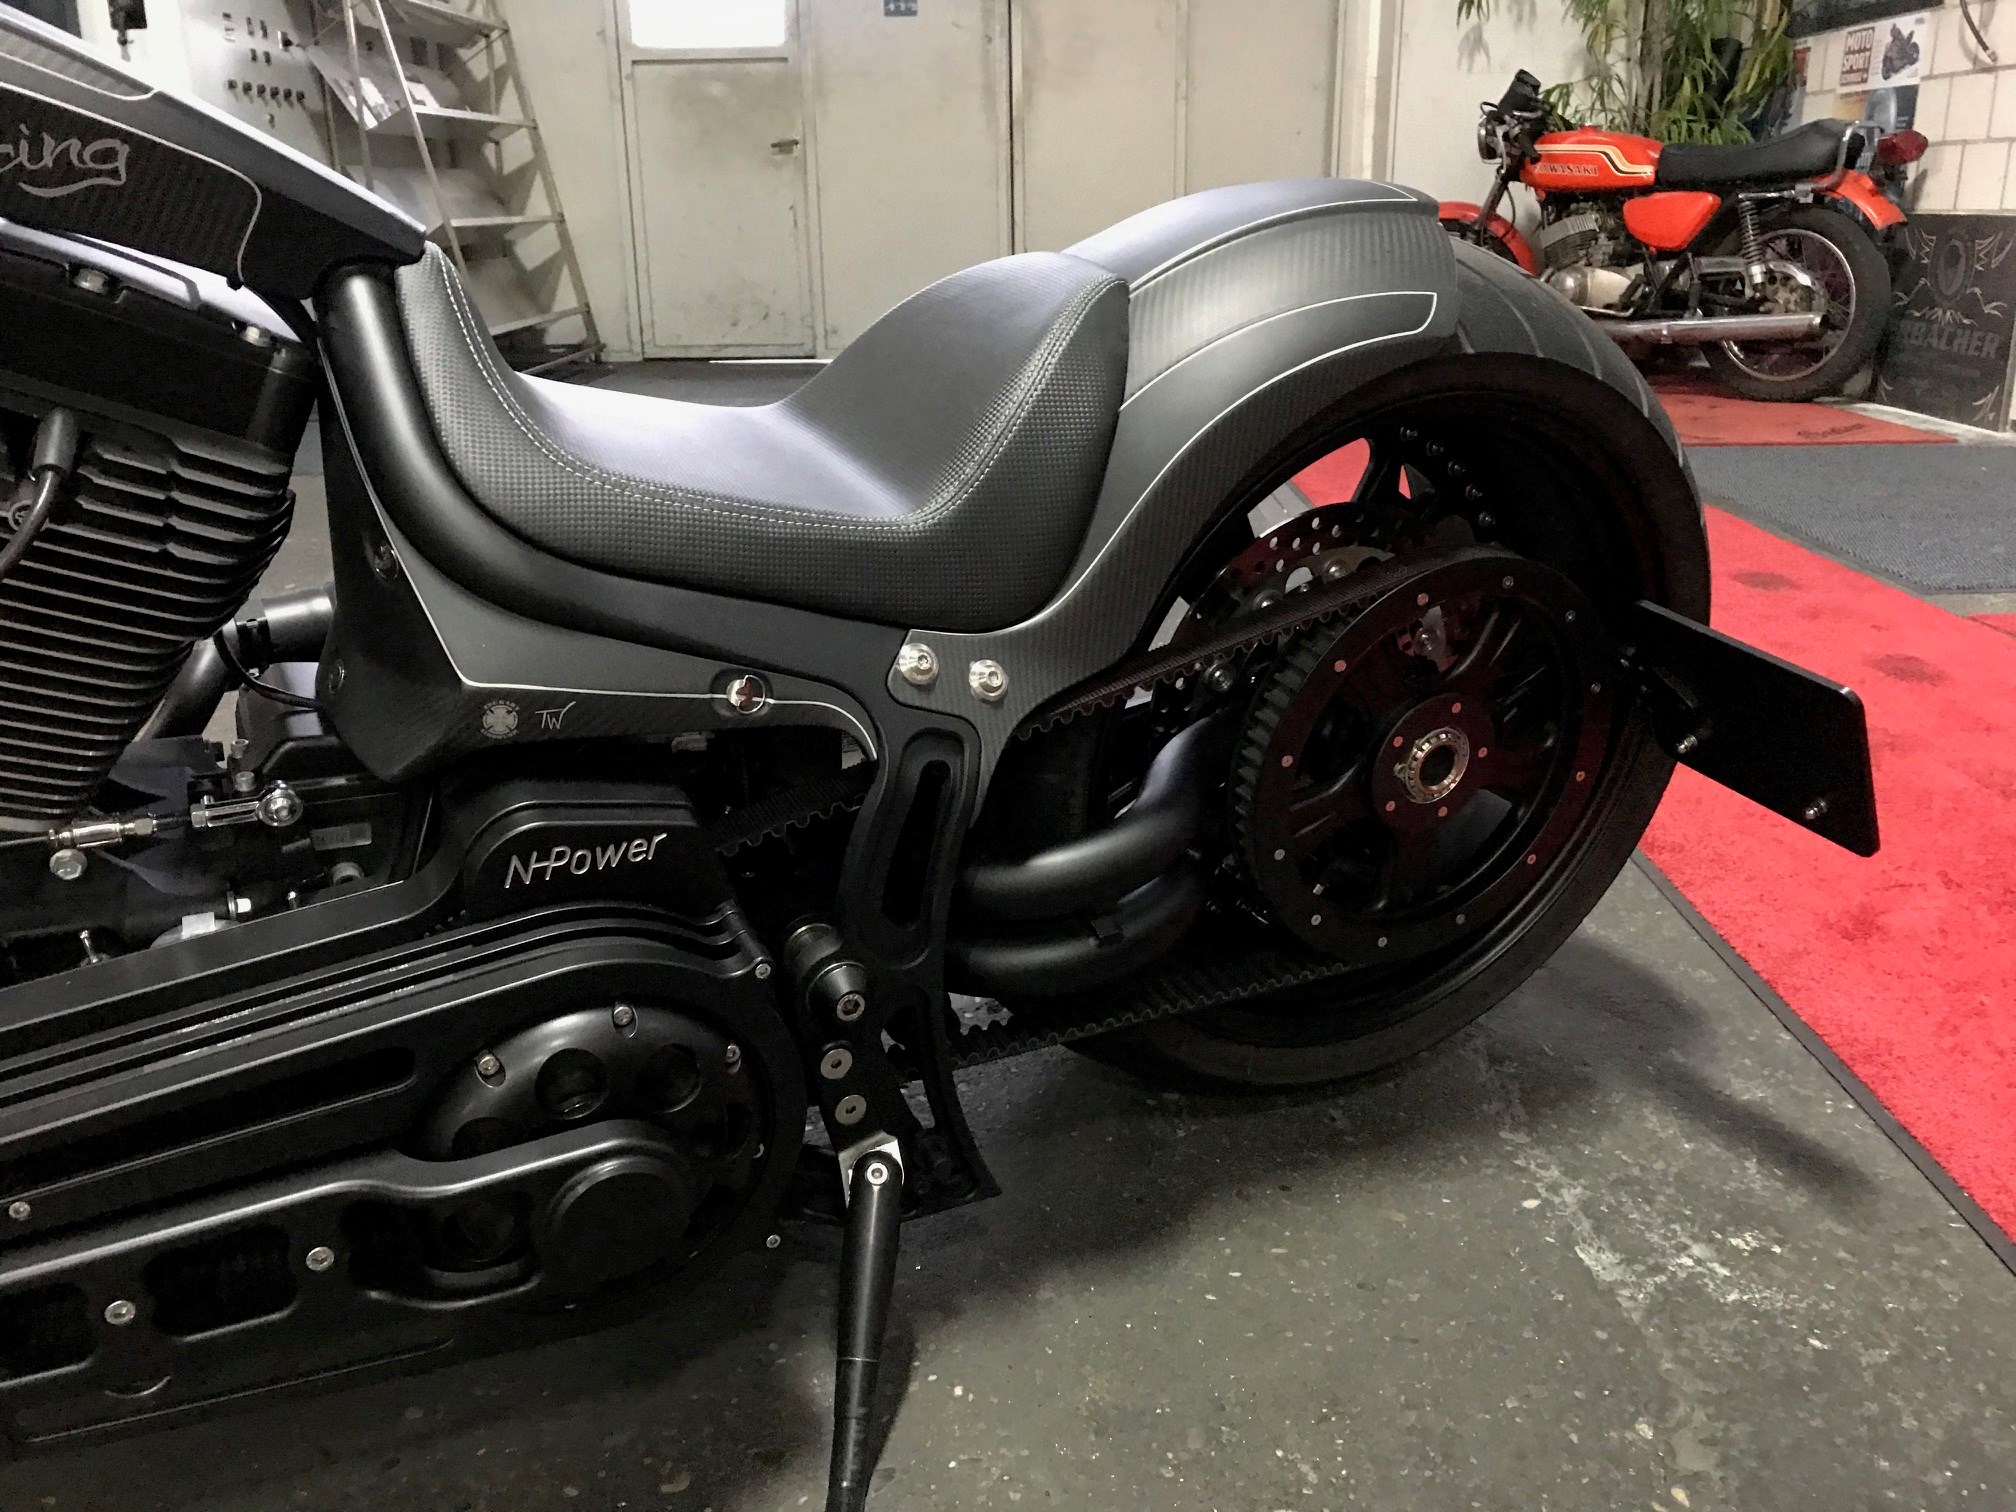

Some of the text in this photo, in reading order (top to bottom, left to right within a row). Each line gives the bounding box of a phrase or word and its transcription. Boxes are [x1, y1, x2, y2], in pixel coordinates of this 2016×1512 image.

[1845, 29, 1874, 52] MOTO
[1842, 52, 1870, 72] SPORT
[503, 832, 668, 889] N-Power
